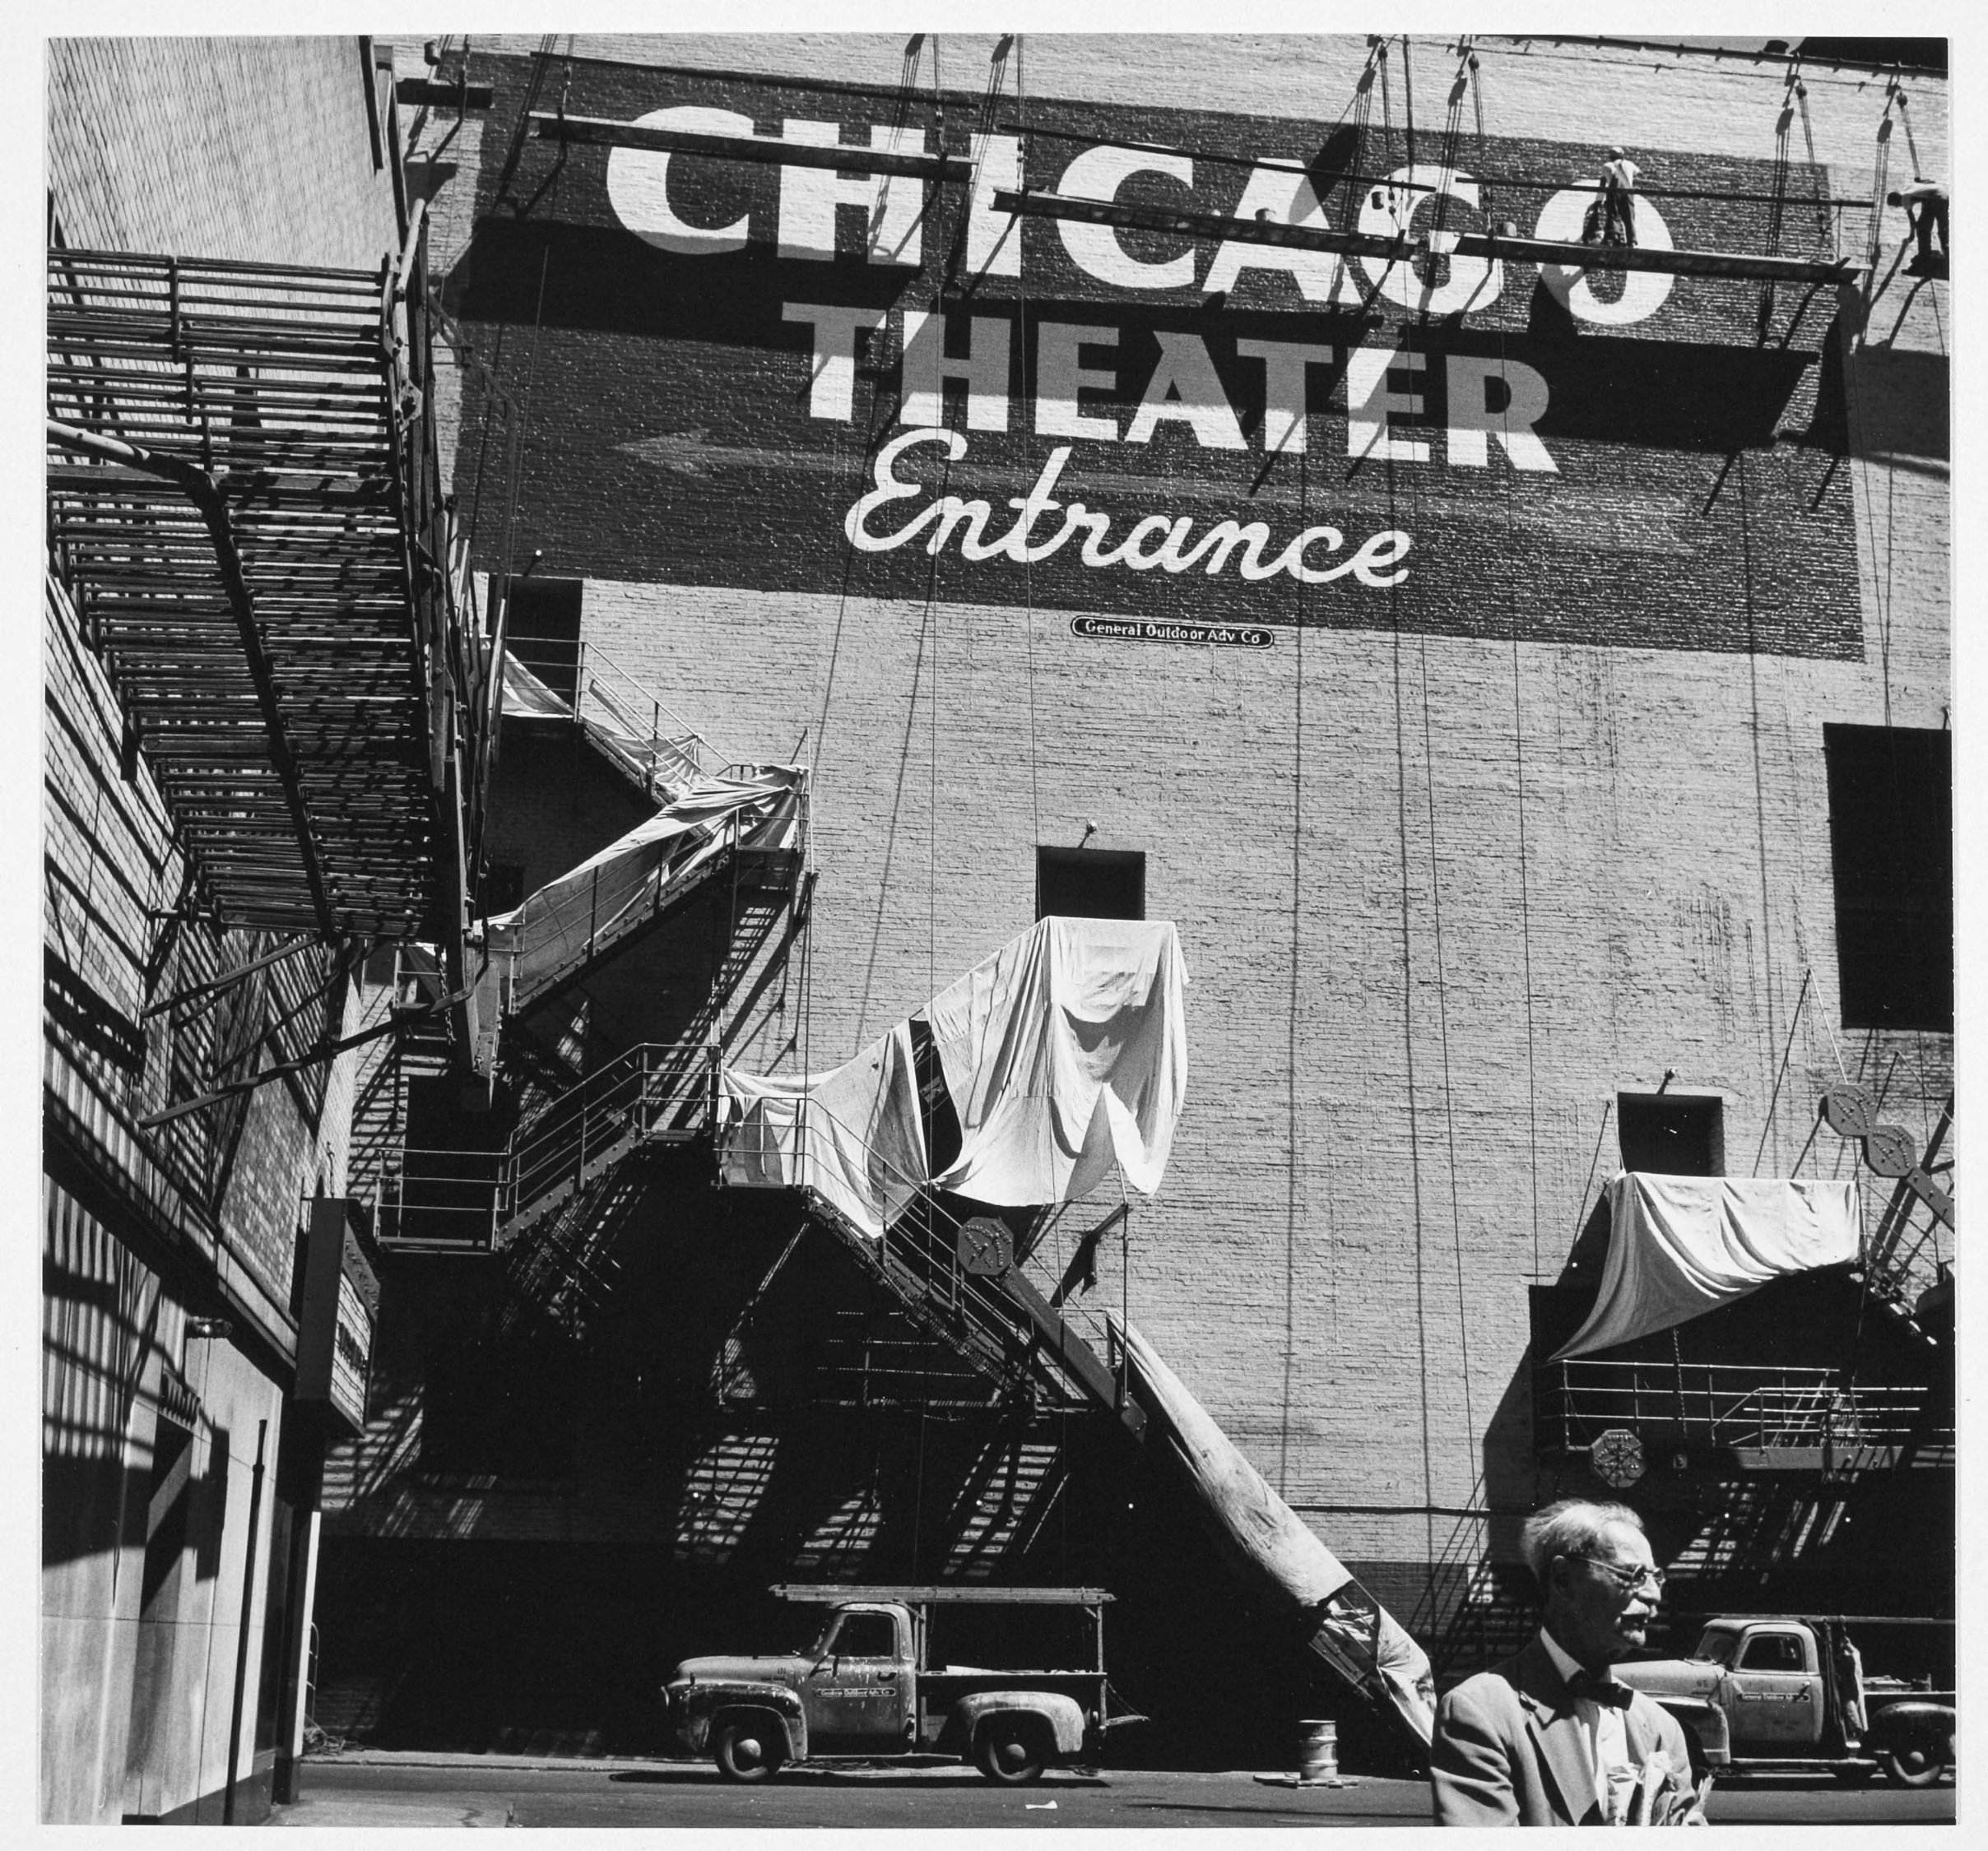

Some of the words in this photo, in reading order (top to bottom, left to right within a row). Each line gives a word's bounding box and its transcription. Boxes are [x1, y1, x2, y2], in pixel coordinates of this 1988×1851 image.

[606, 105, 1675, 326] CHICAGO
[780, 301, 1558, 474] THEATER
[843, 428, 1414, 589] Entrance
[1085, 619, 1141, 637] General
[1145, 624, 1205, 640] Outdoor
[1207, 629, 1236, 642] Adv
[1240, 630, 1261, 644] Co
